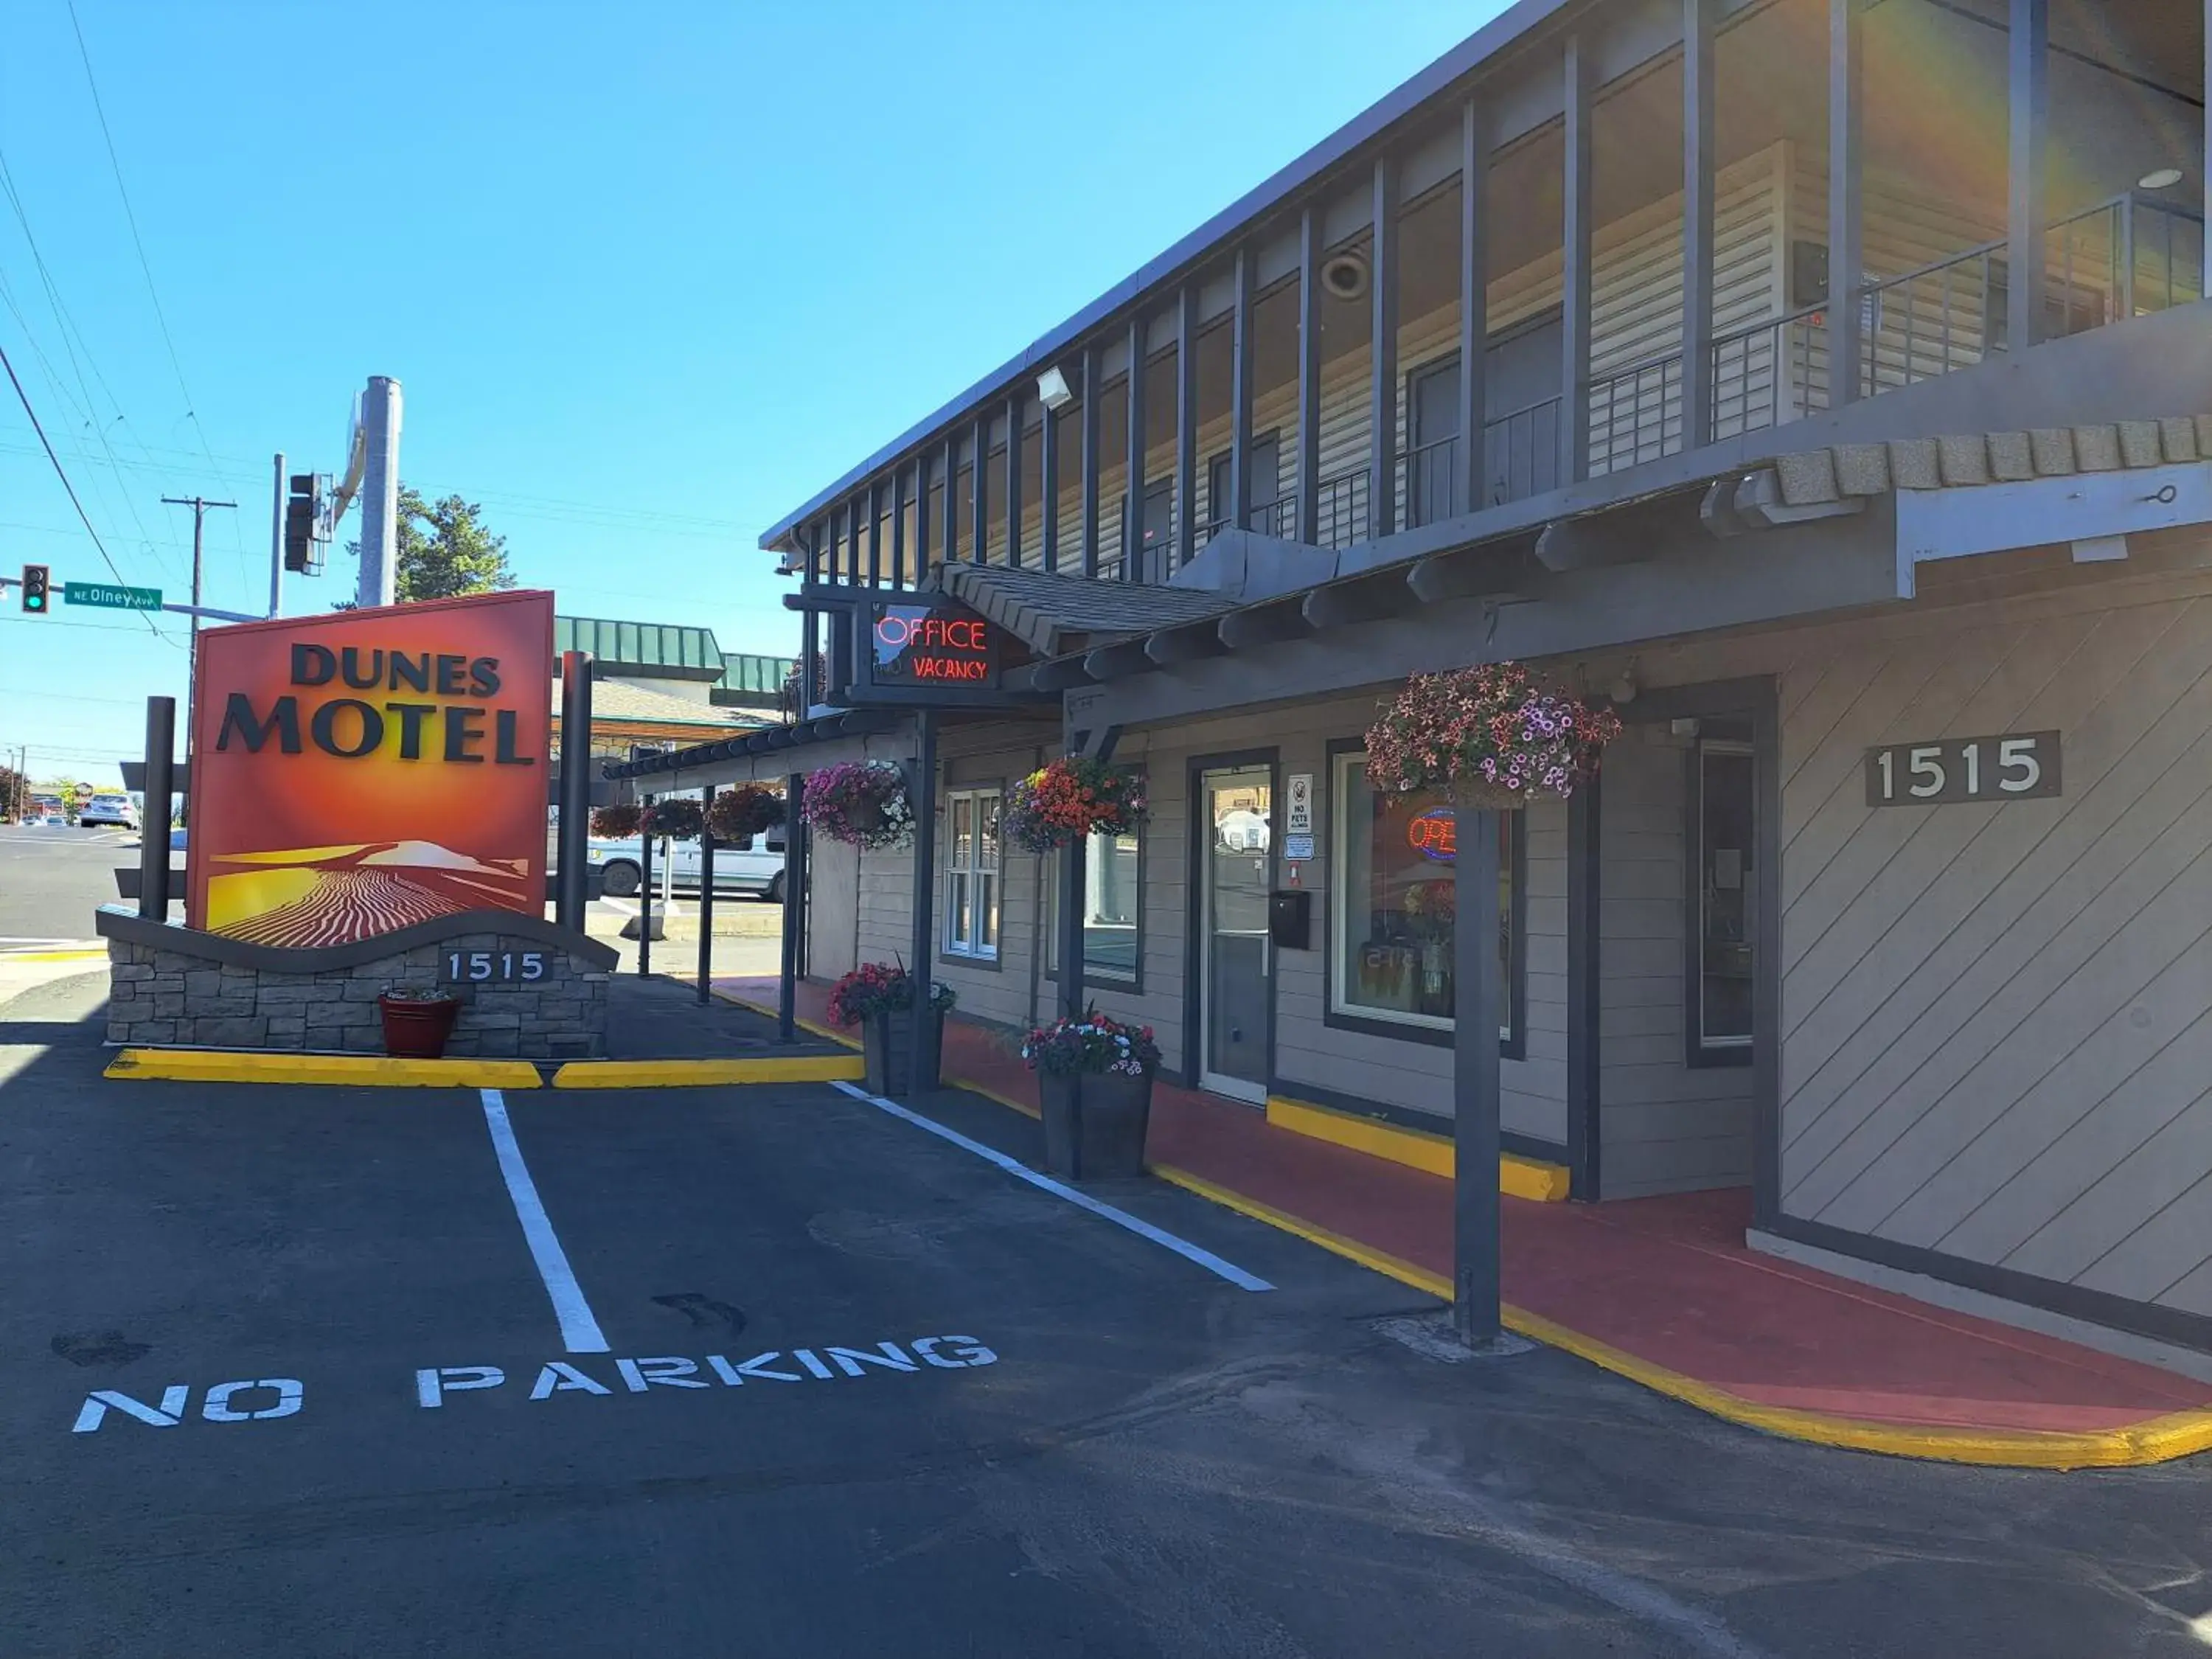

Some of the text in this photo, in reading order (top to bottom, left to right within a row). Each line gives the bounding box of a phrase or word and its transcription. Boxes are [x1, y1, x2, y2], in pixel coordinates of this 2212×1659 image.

[74, 590, 88, 601] NE
[91, 588, 131, 608] Olney
[878, 616, 987, 650] OFFICE
[291, 643, 501, 698] DUNES
[914, 657, 987, 679] VACANCY
[216, 693, 535, 765] MOTEL
[1878, 738, 2040, 799] 1515
[1410, 818, 1456, 852] OPE
[449, 953, 543, 979] 1515
[72, 1335, 998, 1433] NO PARKING
